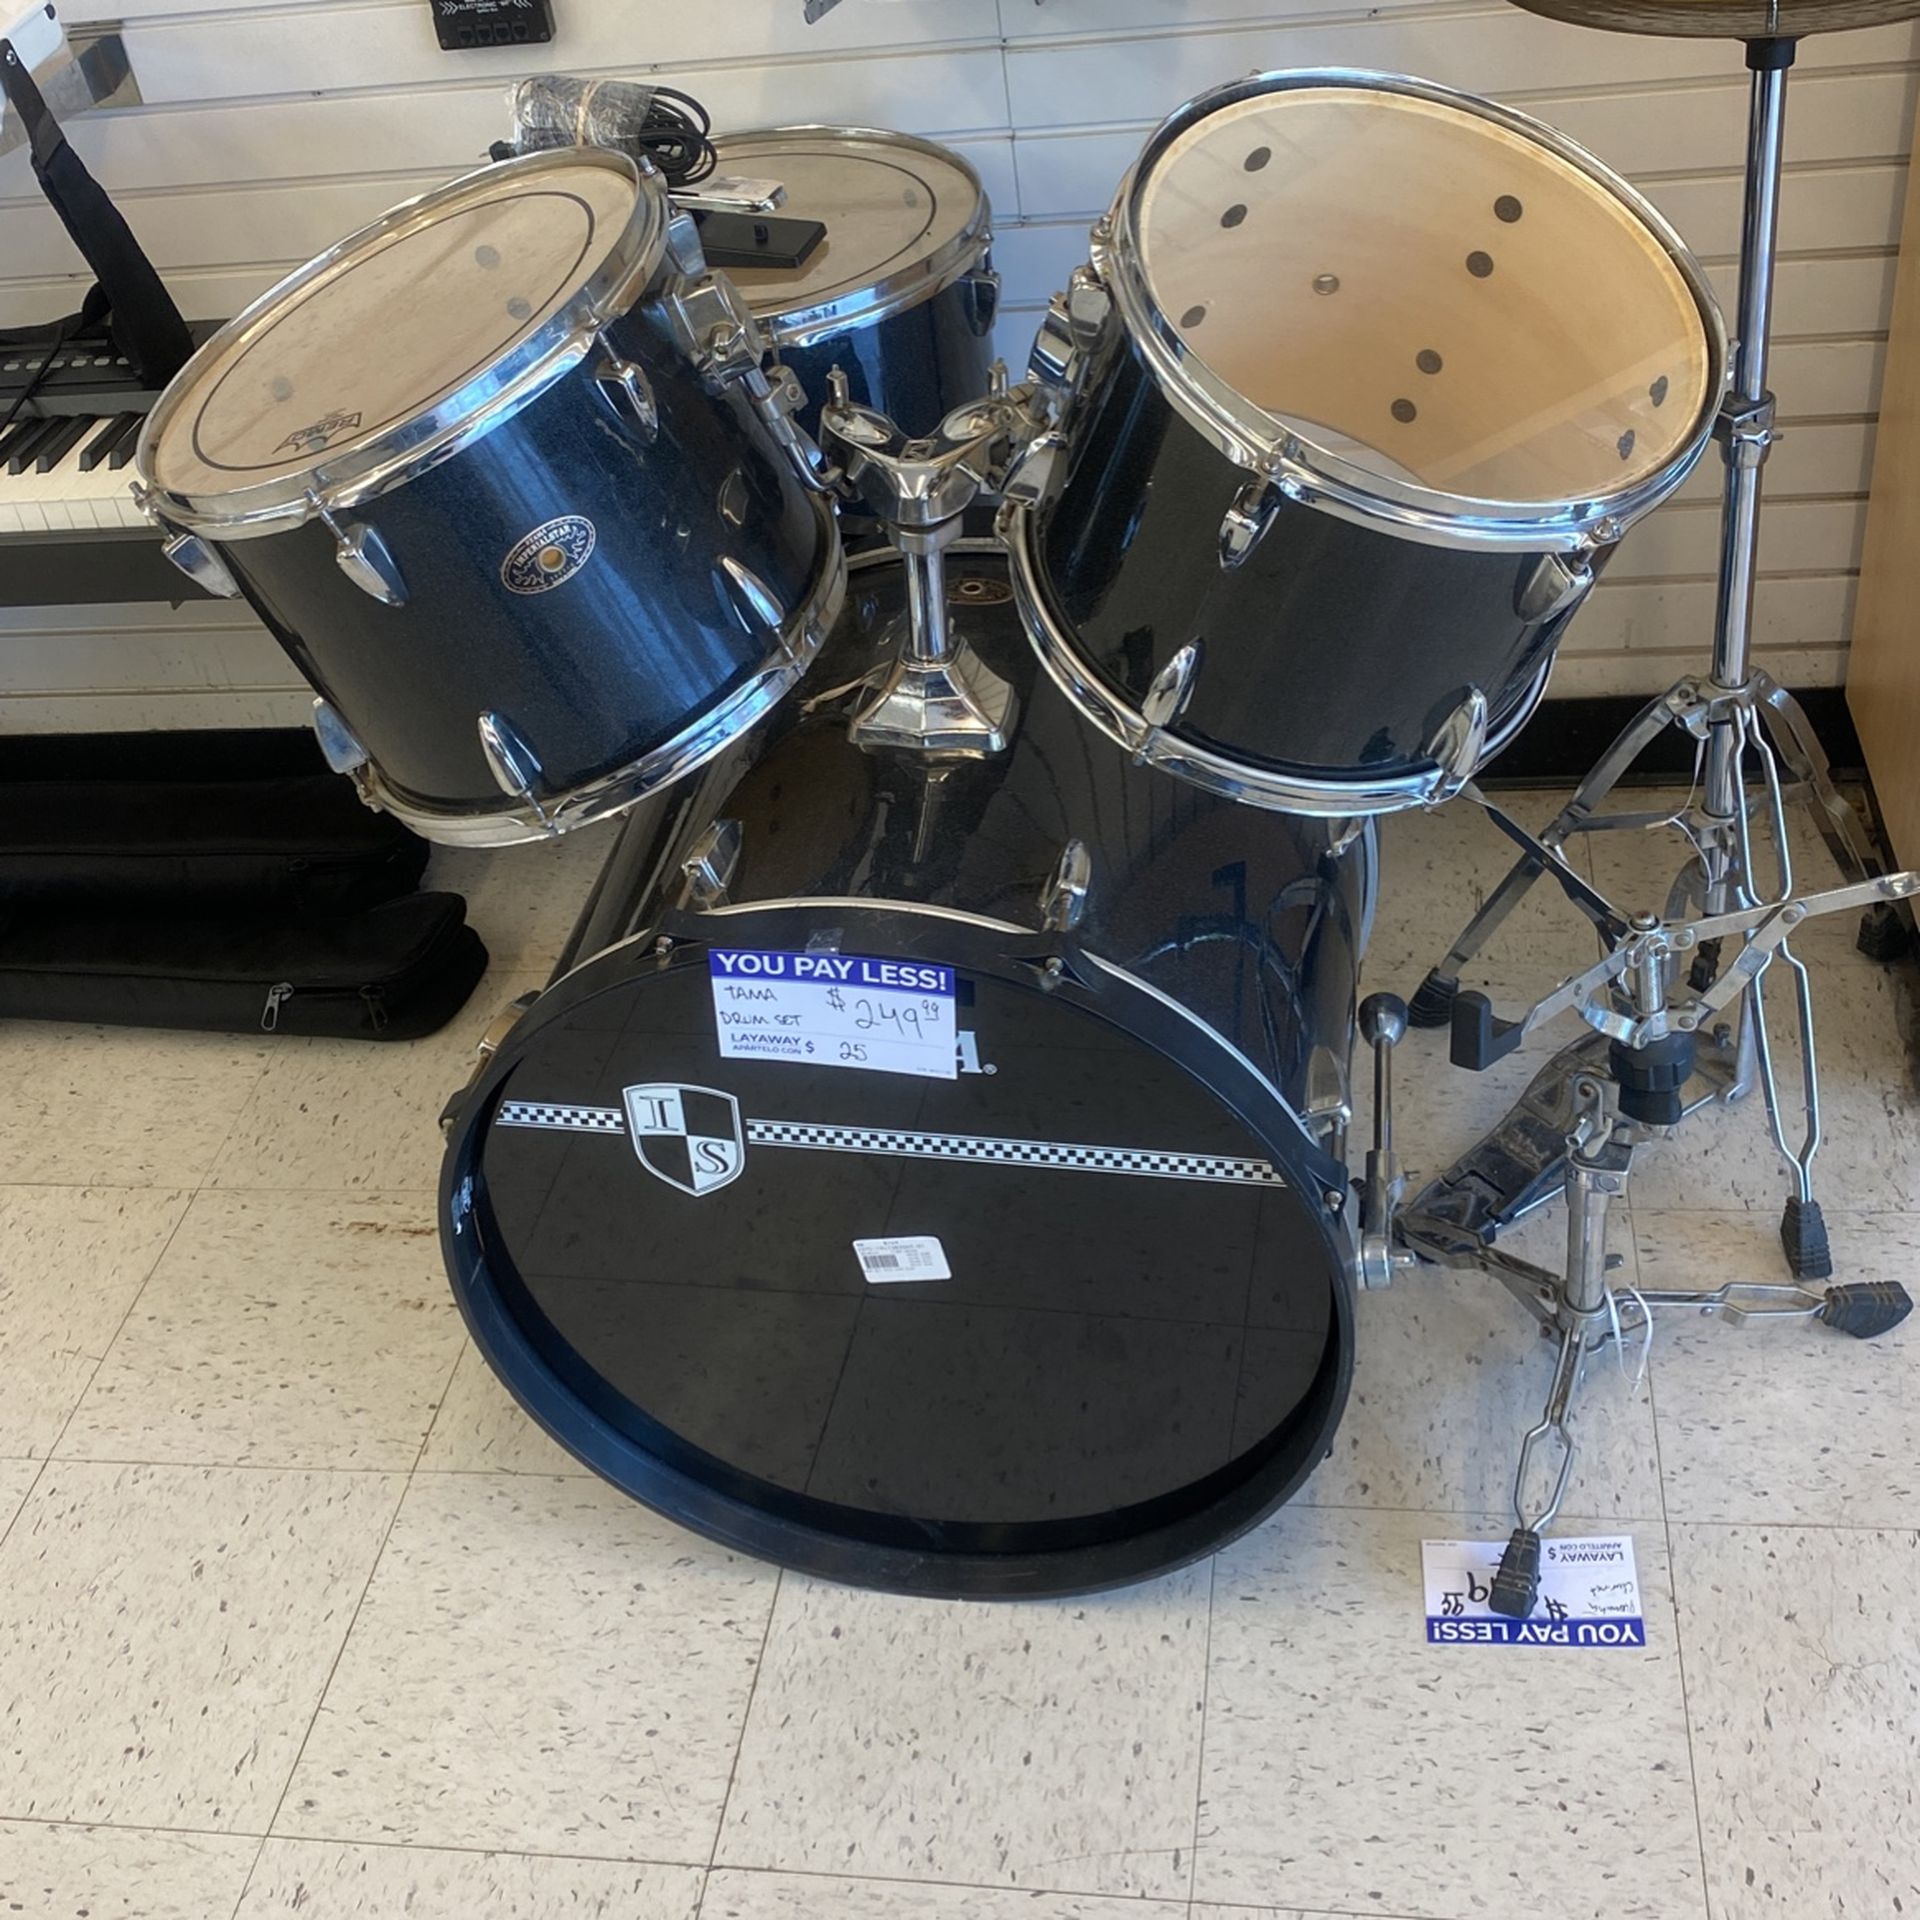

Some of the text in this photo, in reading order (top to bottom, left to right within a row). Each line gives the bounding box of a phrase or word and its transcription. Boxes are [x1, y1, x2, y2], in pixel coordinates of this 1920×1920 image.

[513, 524, 573, 567] IMPERIALSTAR
[717, 953, 947, 991] YOU PAY LESS!
[724, 985, 778, 1001] TAMA
[719, 1011, 802, 1026] DRUM SET
[731, 1033, 868, 1061] LAYAWAY $ 25
[695, 1141, 729, 1175] S
[1547, 1547, 1624, 1563] LAYAWAY $
[1433, 1622, 1639, 1643] YOU PAY LESS!
